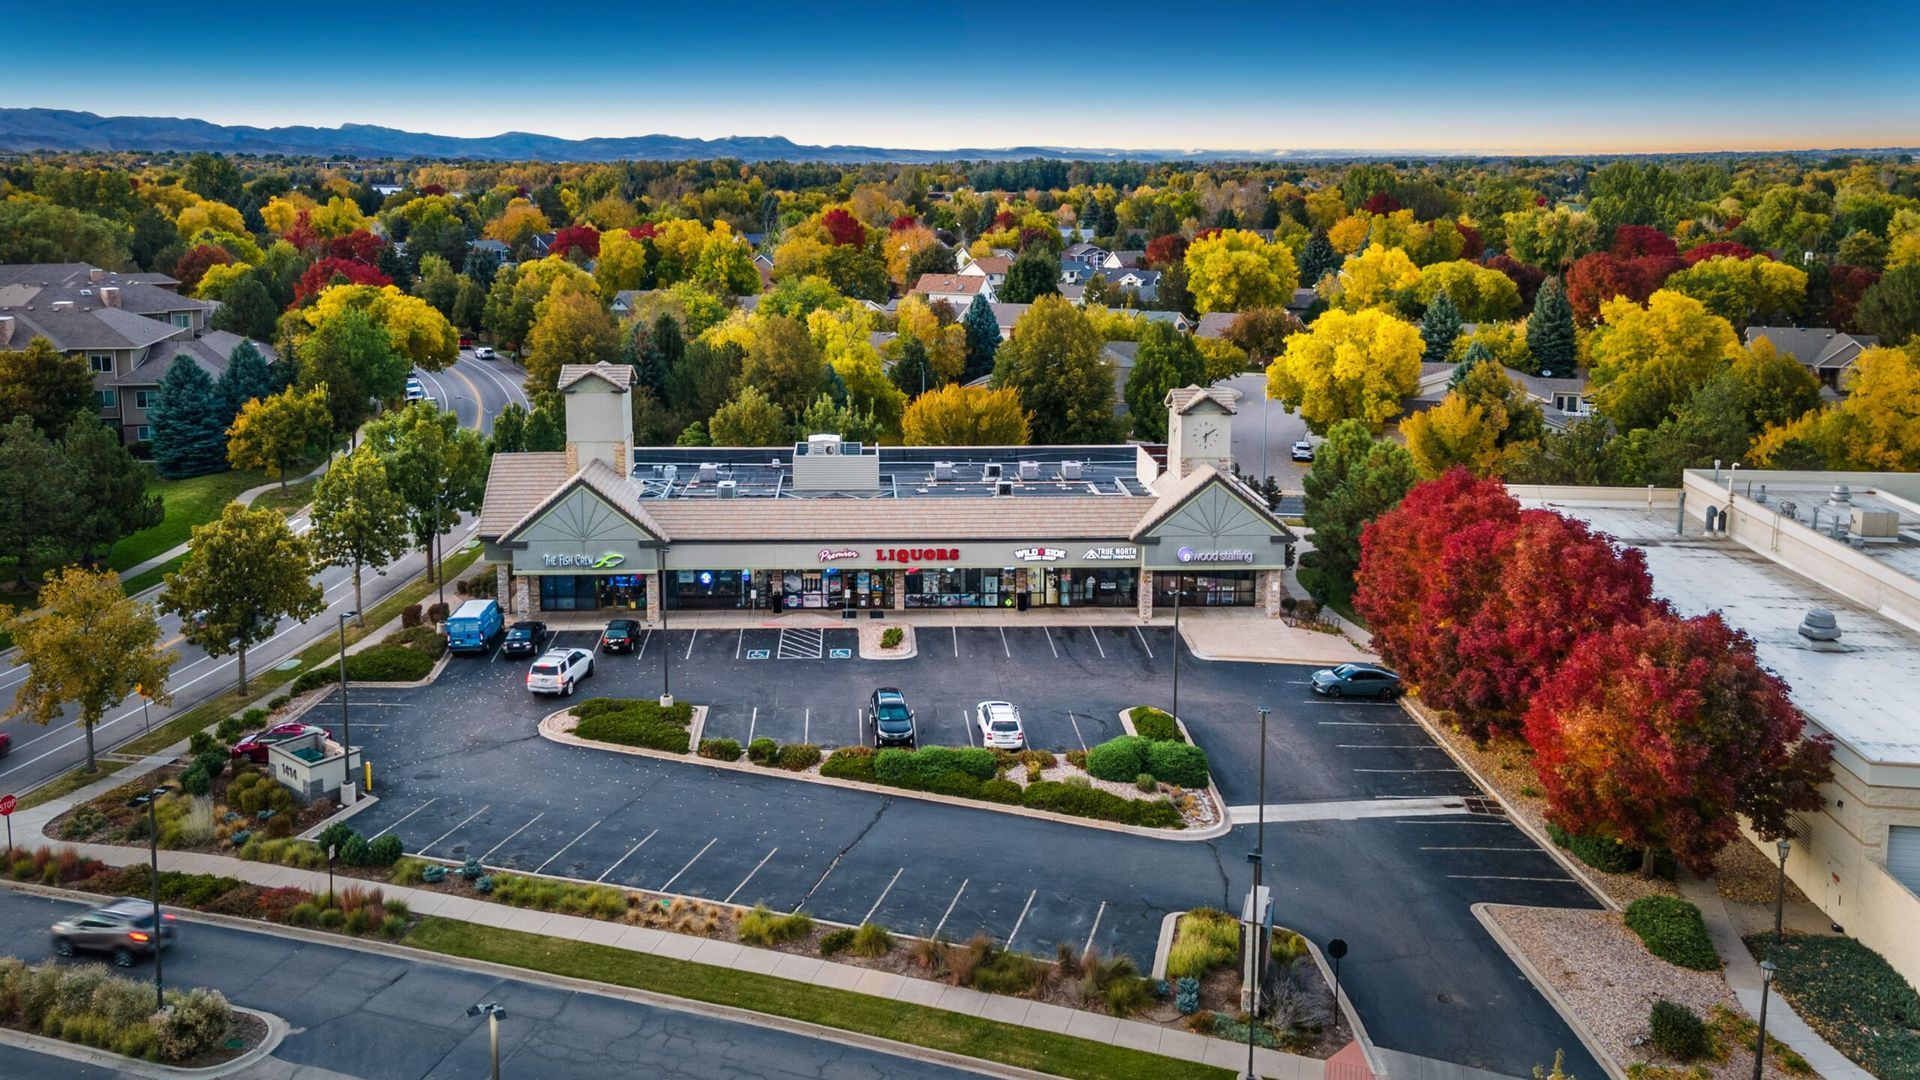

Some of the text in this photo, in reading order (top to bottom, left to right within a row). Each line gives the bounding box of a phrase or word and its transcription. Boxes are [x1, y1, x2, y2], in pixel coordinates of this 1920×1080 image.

[818, 548, 960, 563] Premier LIQUORS
[1015, 548, 1066, 558] WILD SIDE
[1219, 550, 1253, 563] staffing
[281, 763, 297, 780] 1414
[0, 798, 15, 812] STOP
